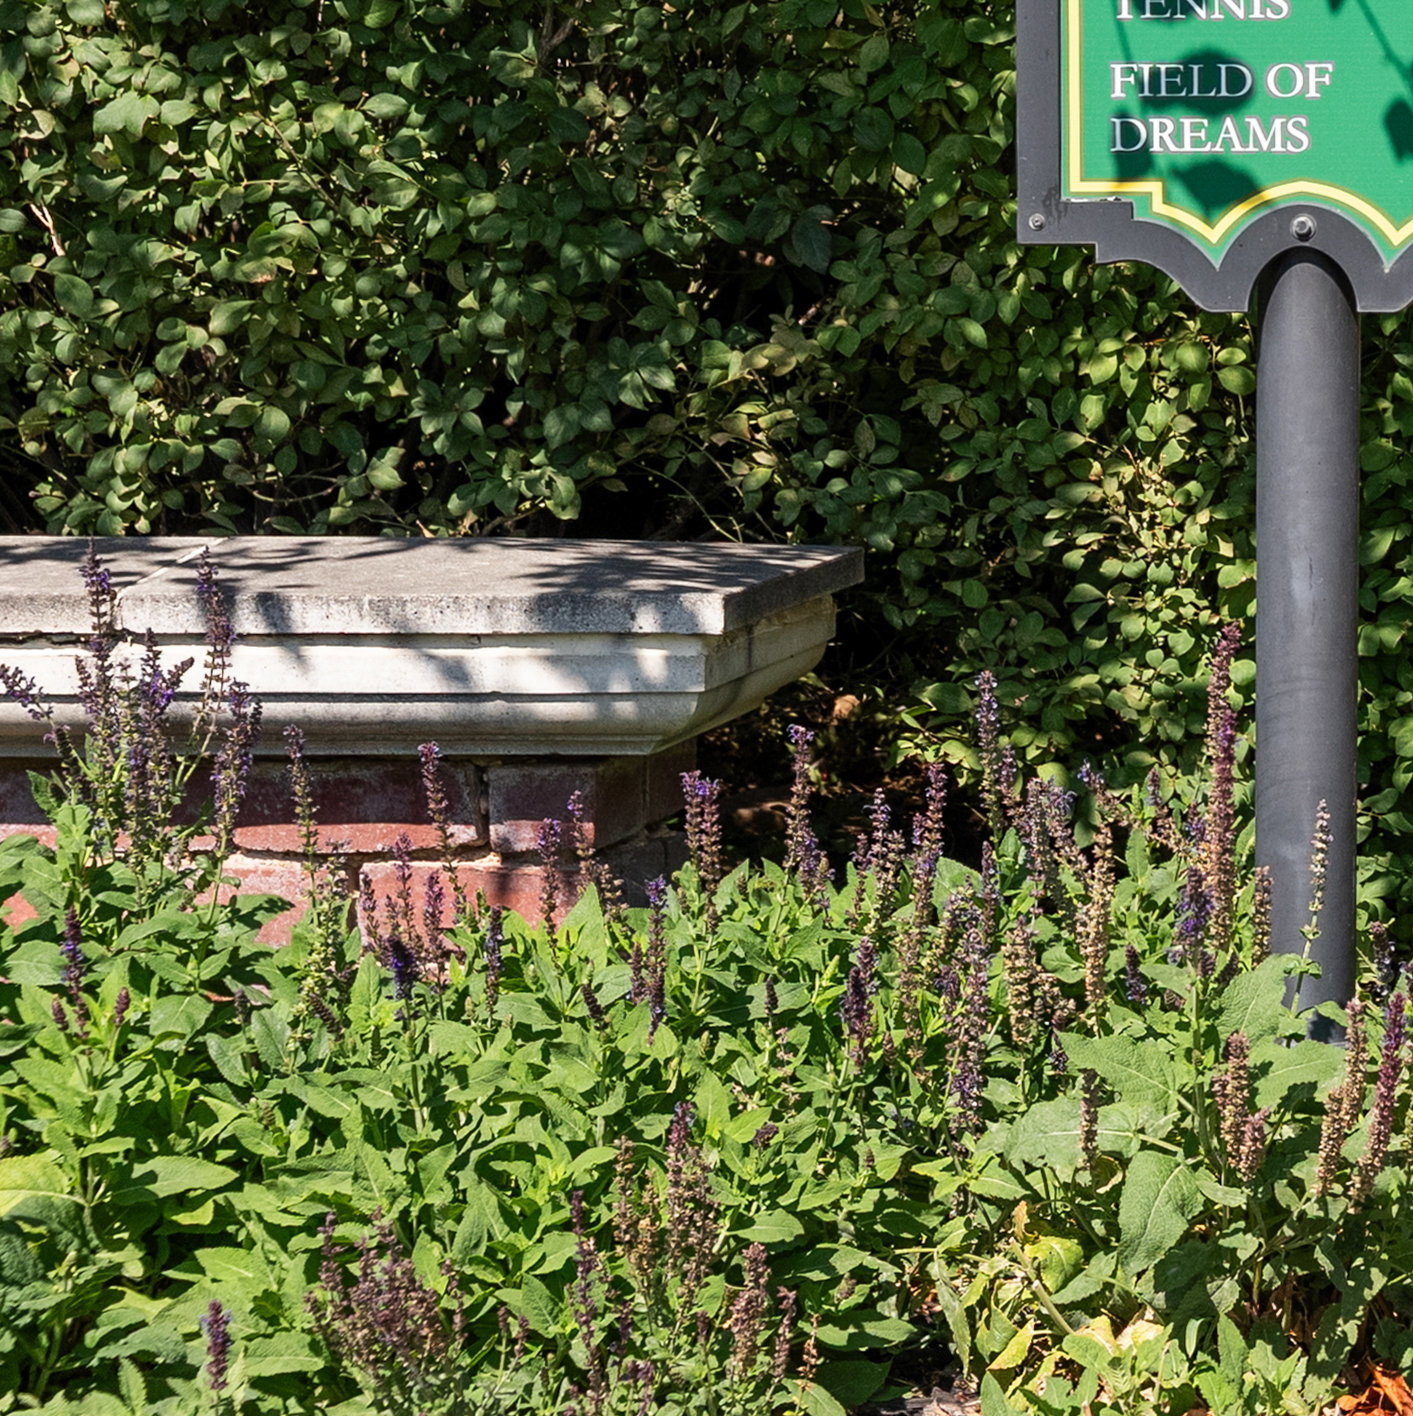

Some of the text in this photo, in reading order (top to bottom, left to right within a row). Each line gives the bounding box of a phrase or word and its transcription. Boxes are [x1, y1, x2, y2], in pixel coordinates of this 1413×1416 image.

[1110, 63, 1335, 99] FIELD OF
[1110, 116, 1311, 153] DREAMS
